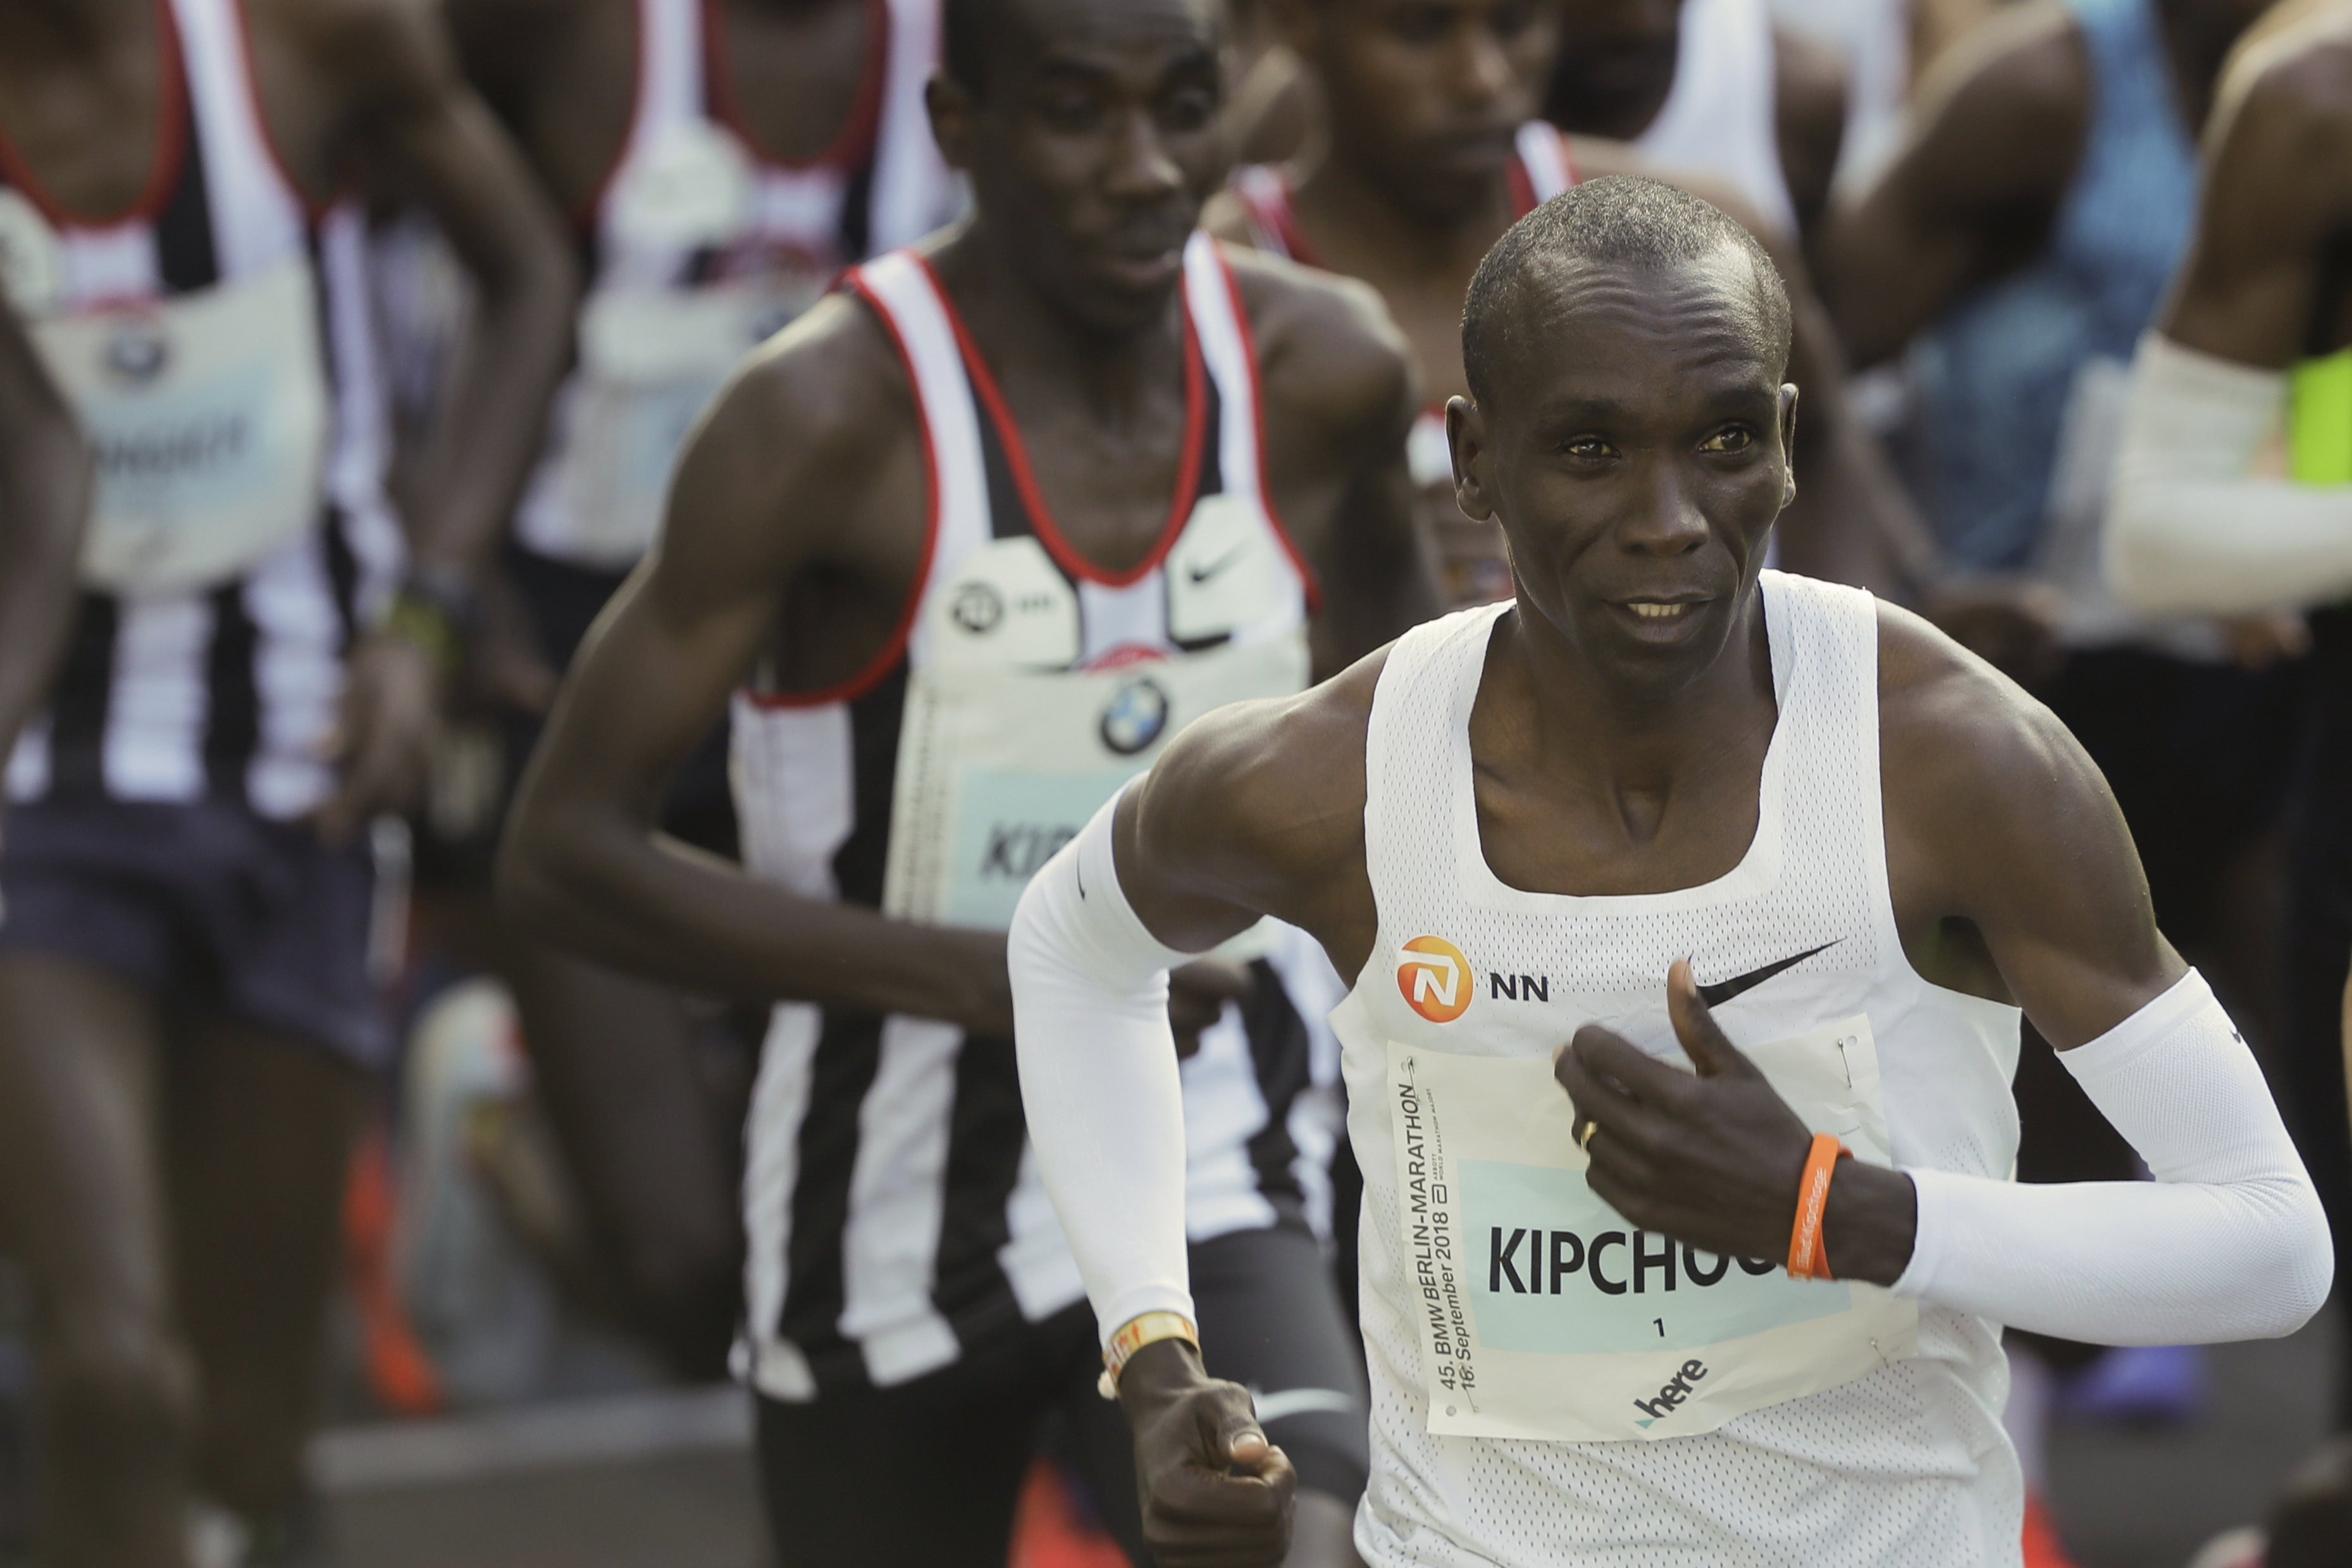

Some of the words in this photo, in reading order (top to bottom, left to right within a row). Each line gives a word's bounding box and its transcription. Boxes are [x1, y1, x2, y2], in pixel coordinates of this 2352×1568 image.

[1490, 973, 1549, 1002] NN
[1425, 1088, 1437, 1114] MAJORS
[1432, 1116, 1443, 1155] MARATHON
[1398, 1083, 1440, 1300] BERLIN-MARATHON
[1432, 1211, 1451, 1260] 2018
[1427, 1302, 1451, 1355] BMW
[1442, 1264, 1471, 1361] September
[1653, 1318, 1665, 1337] 1
[1438, 1361, 1457, 1390] 45.
[1633, 1358, 1709, 1419] here
